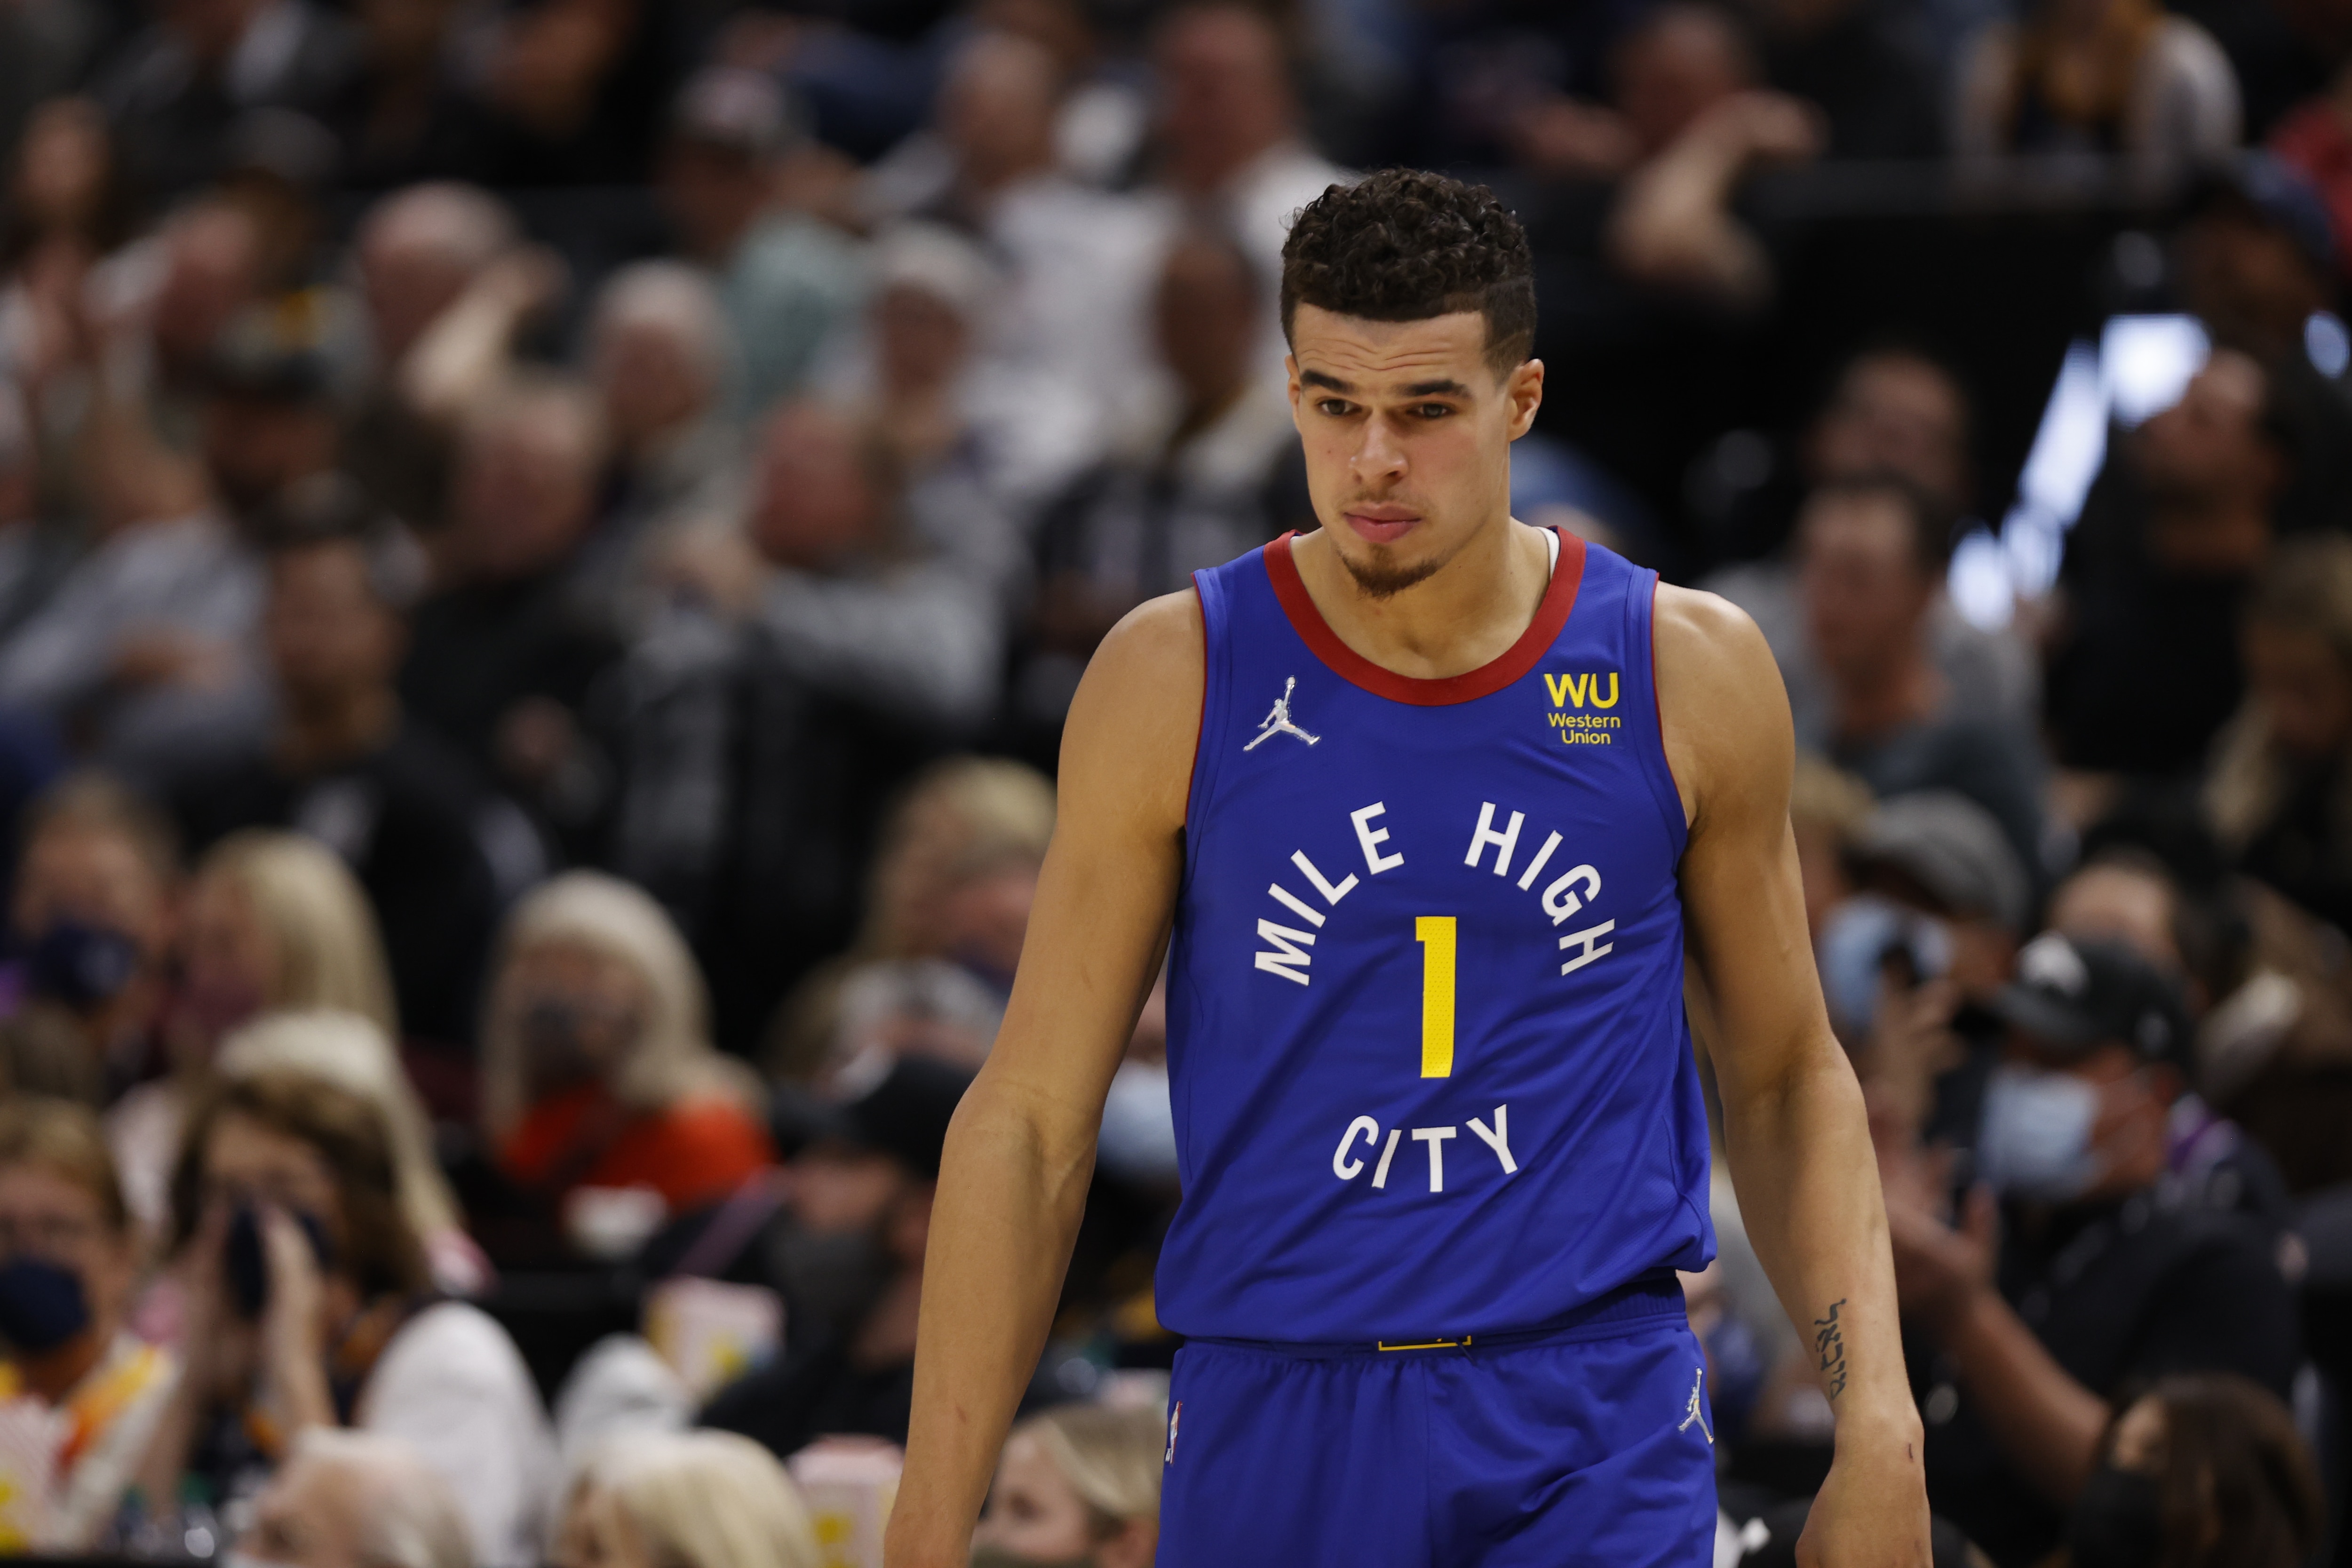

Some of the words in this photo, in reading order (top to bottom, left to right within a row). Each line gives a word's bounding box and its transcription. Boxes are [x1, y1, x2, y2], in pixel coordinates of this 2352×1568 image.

[1543, 672, 1619, 708] WU
[1548, 712, 1621, 728] Western
[1561, 729, 1611, 744] Union
[1255, 801, 1405, 986] MILE
[1464, 801, 1615, 976] HIGH
[1415, 916, 1457, 1078] 1
[1333, 1104, 1518, 1193] CITY
